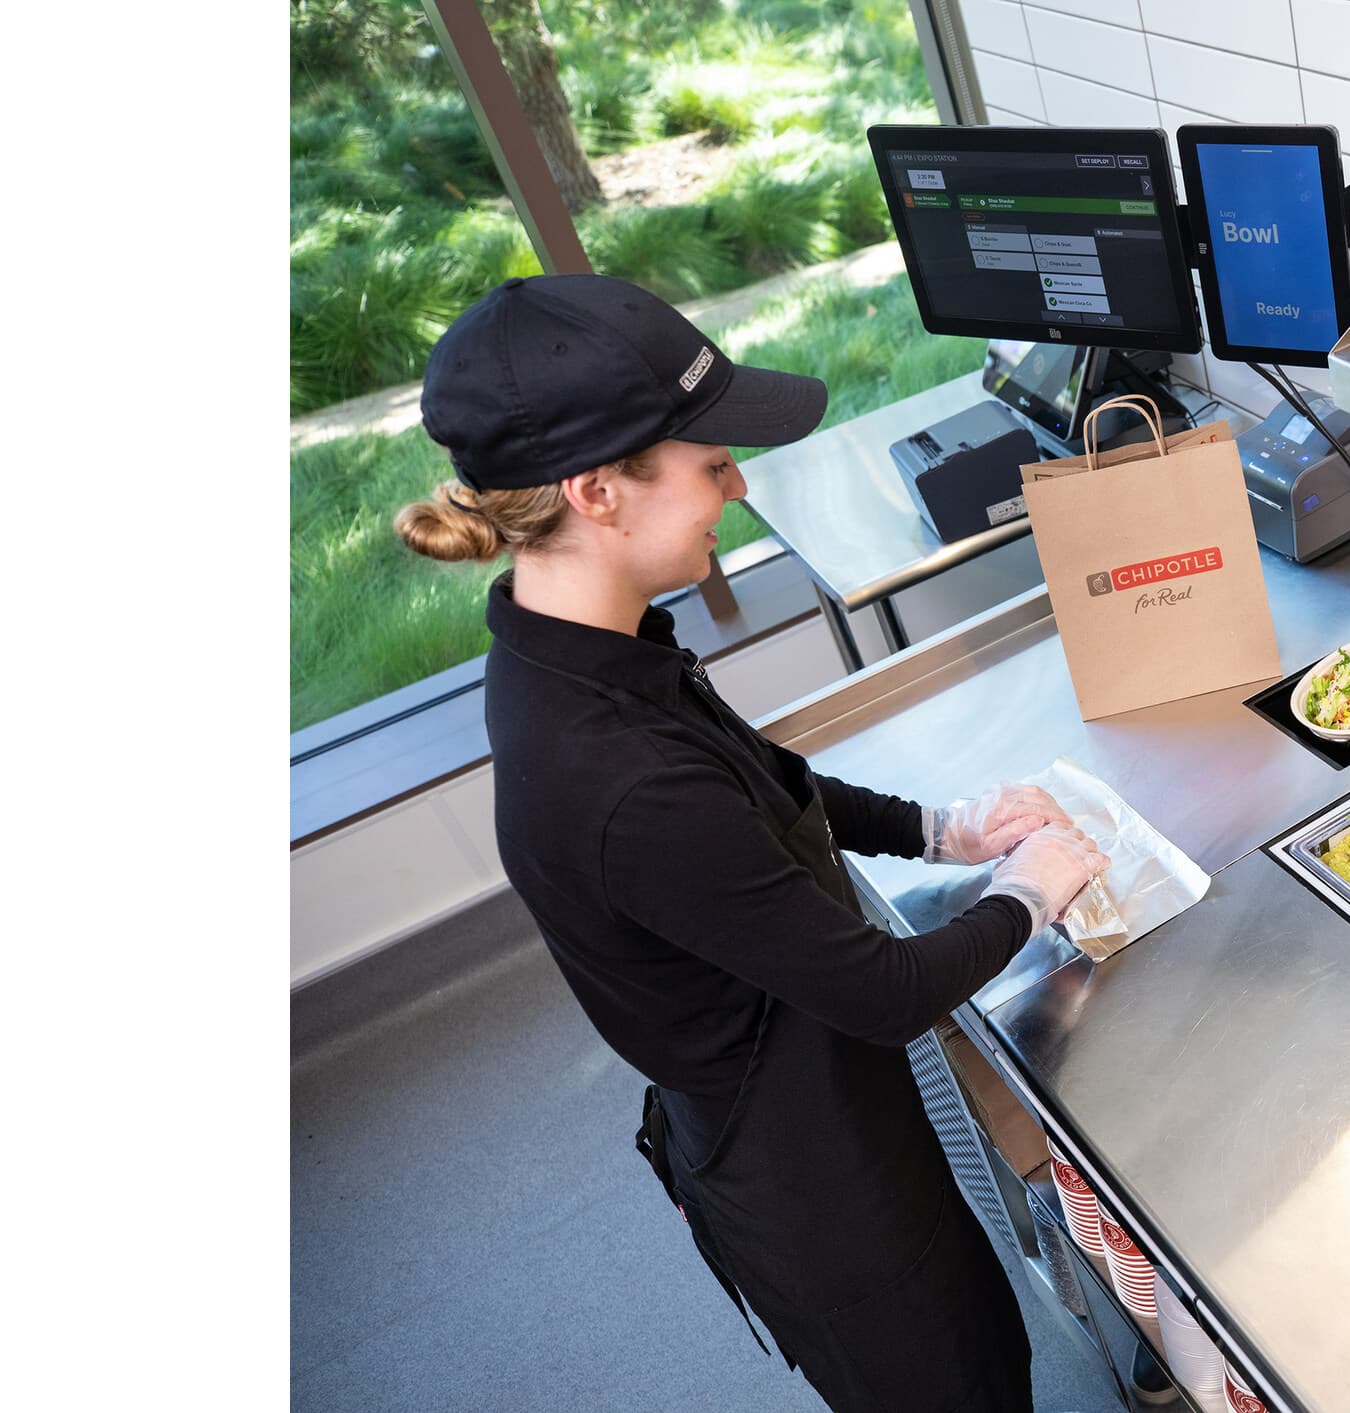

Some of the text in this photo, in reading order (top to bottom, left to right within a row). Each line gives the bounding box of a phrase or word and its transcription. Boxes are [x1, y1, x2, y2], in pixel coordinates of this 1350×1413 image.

[1219, 210, 1236, 219] Lucy
[1223, 221, 1280, 244] Bowl
[1256, 302, 1300, 319] Ready
[1117, 552, 1217, 585] CHIPOTLE
[1134, 585, 1192, 614] for Real
